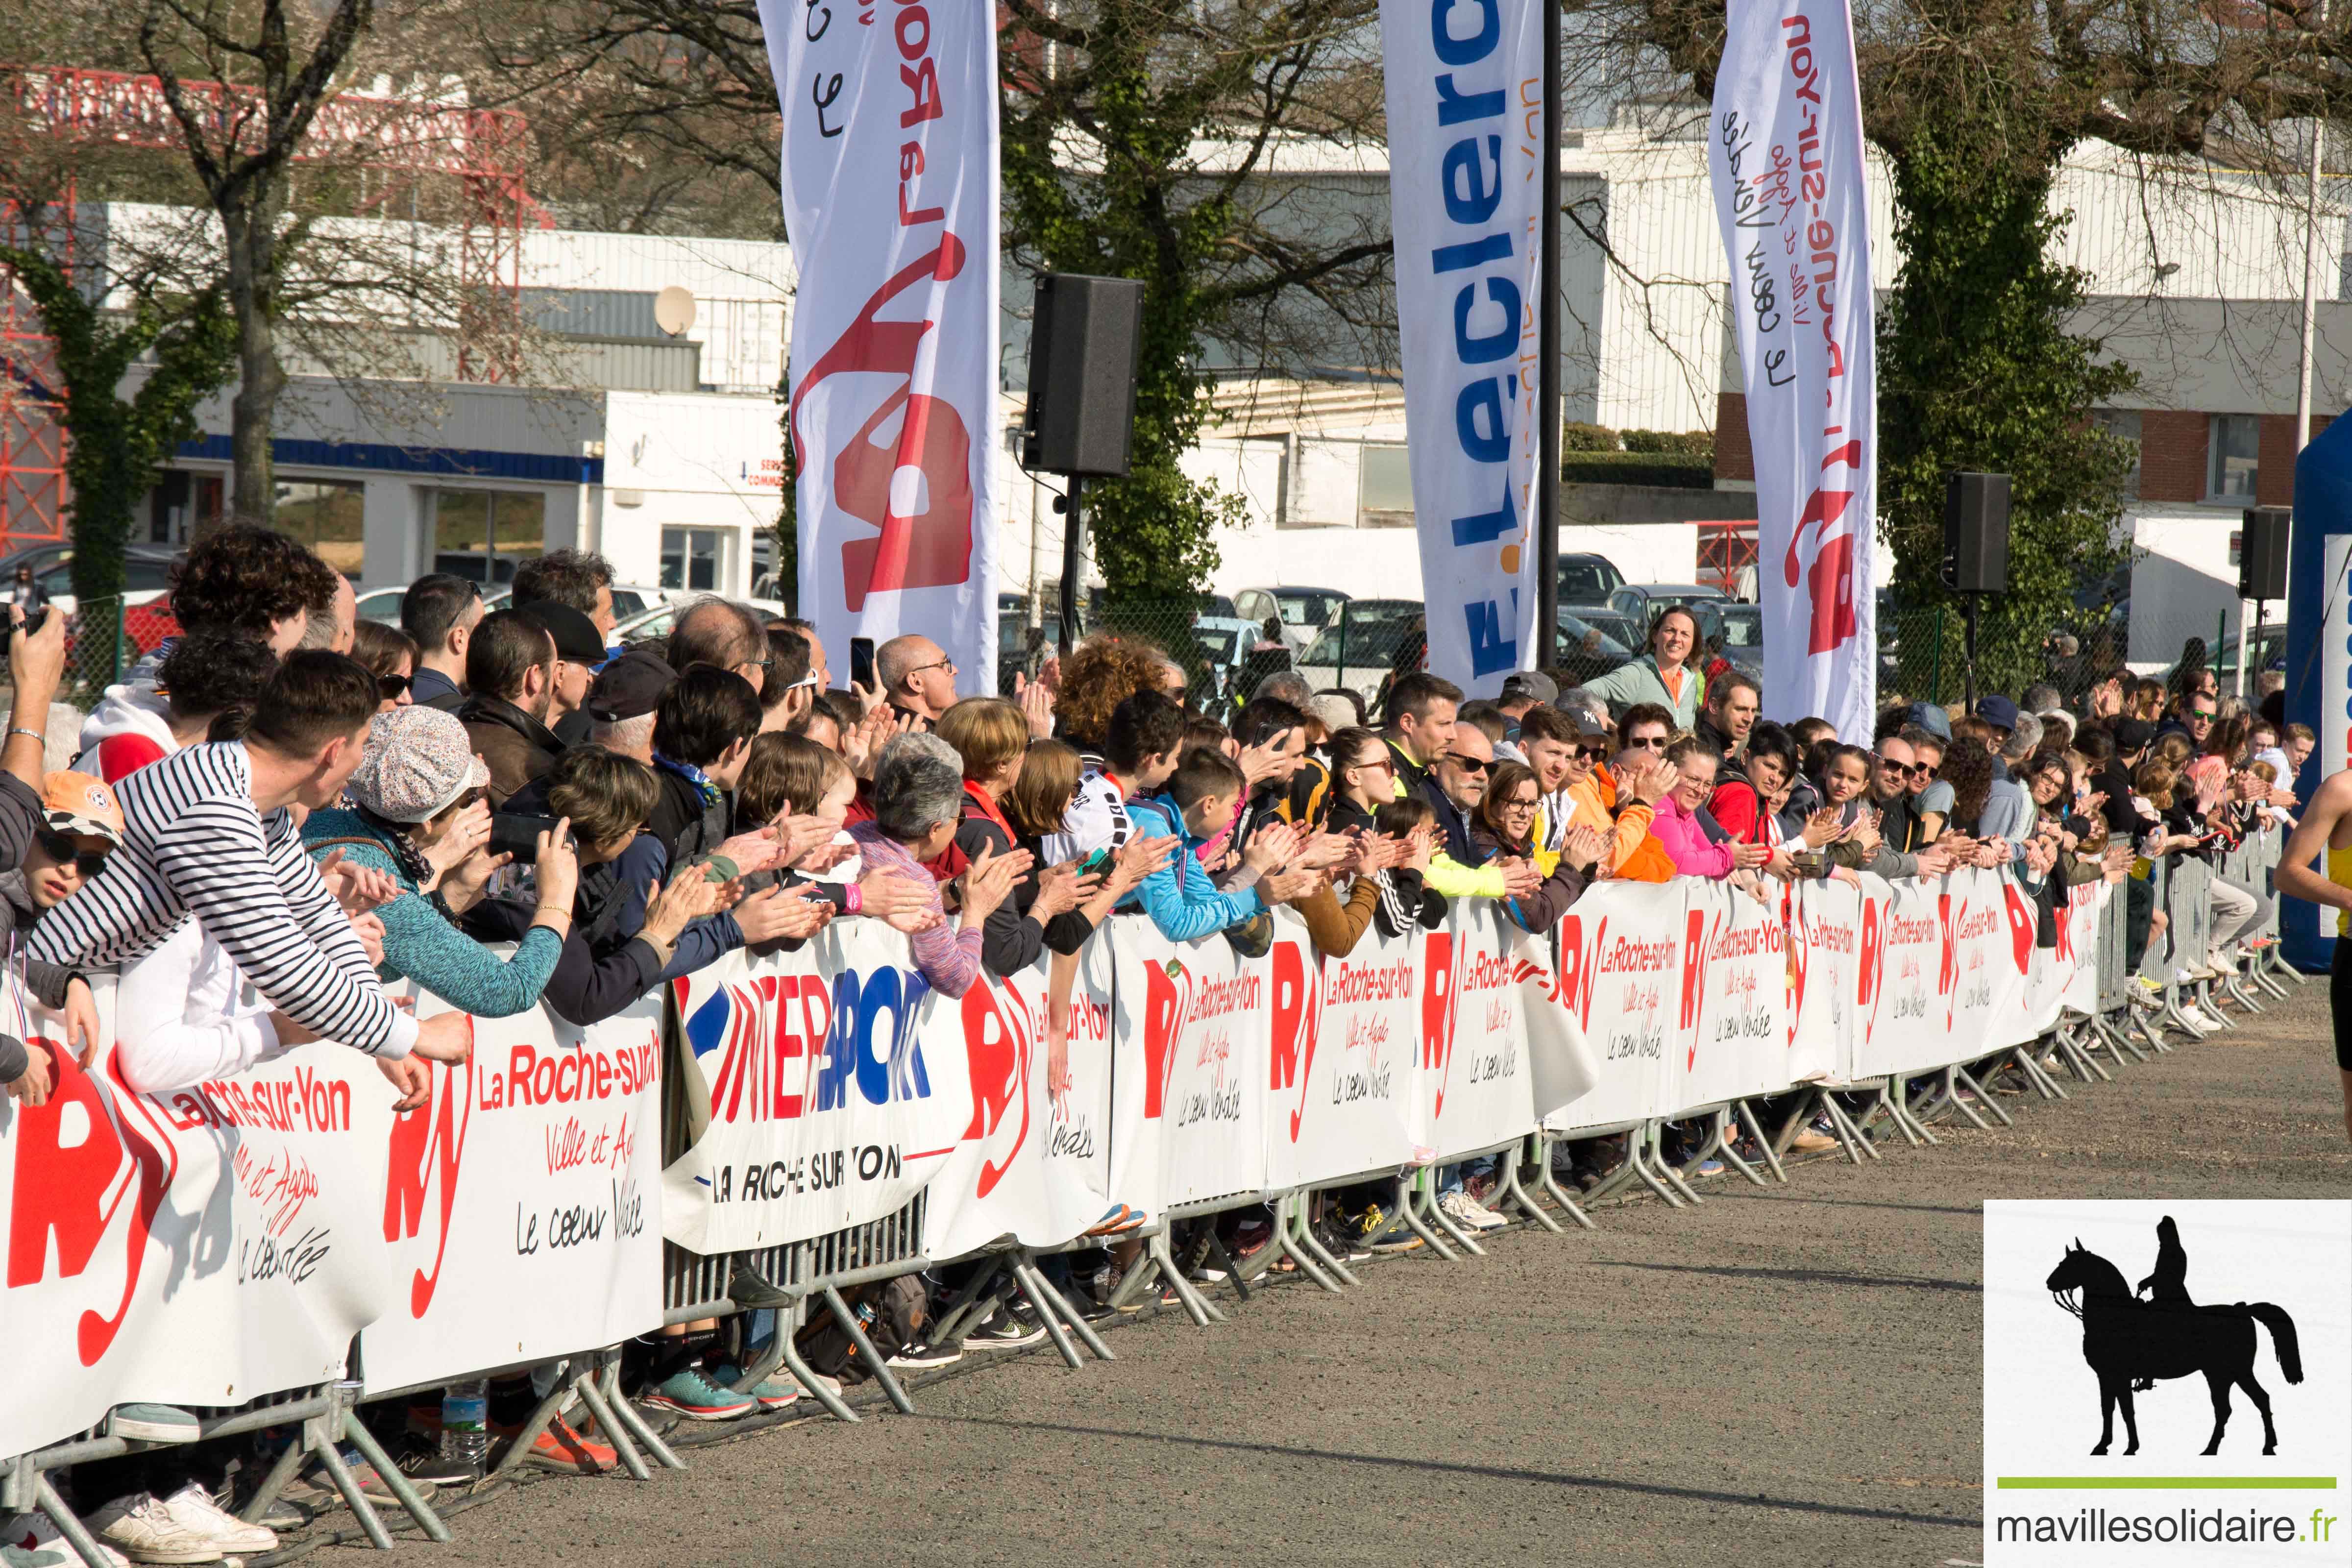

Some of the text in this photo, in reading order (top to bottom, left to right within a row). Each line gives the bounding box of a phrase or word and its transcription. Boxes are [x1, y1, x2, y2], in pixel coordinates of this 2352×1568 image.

[1893, 913, 1936, 945] Roche-sur-Yon
[1613, 933, 1676, 973] Roche-sur-Yon
[1338, 956, 1413, 1004] Roche-sur-Yon
[479, 1065, 503, 1111] La
[713, 1165, 732, 1203] LA
[741, 1157, 804, 1201] ROCHE
[811, 1150, 844, 1191] SUR
